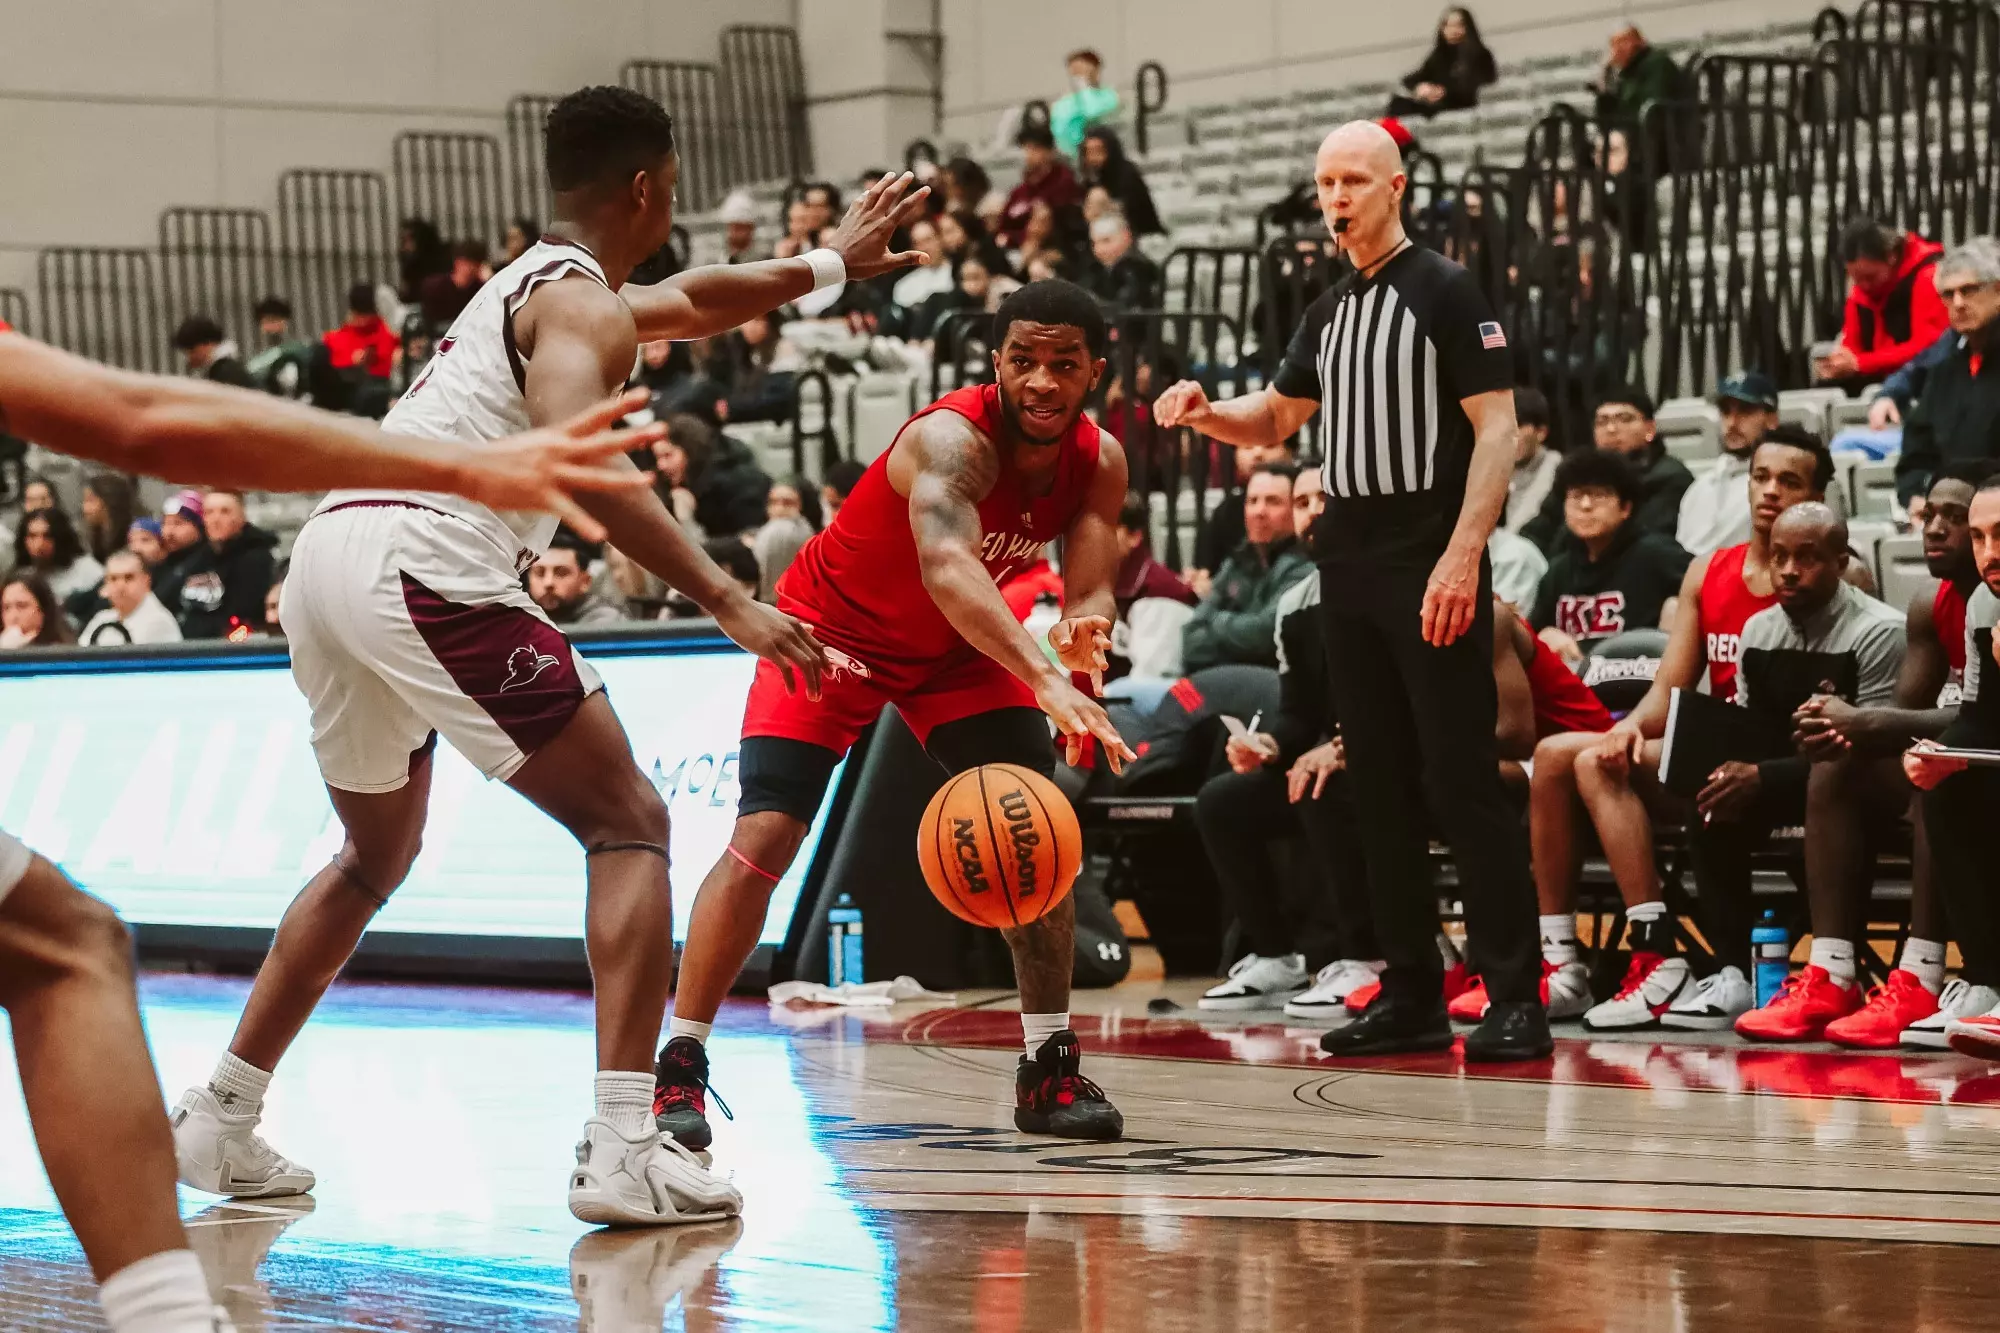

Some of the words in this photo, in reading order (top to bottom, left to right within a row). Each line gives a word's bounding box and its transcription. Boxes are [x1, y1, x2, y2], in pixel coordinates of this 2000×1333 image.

[980, 532, 1006, 561] ED
[1707, 632, 1739, 662] RED
[650, 751, 740, 807] MOE
[952, 817, 990, 893] NCAA
[998, 789, 1041, 899] Wilson
